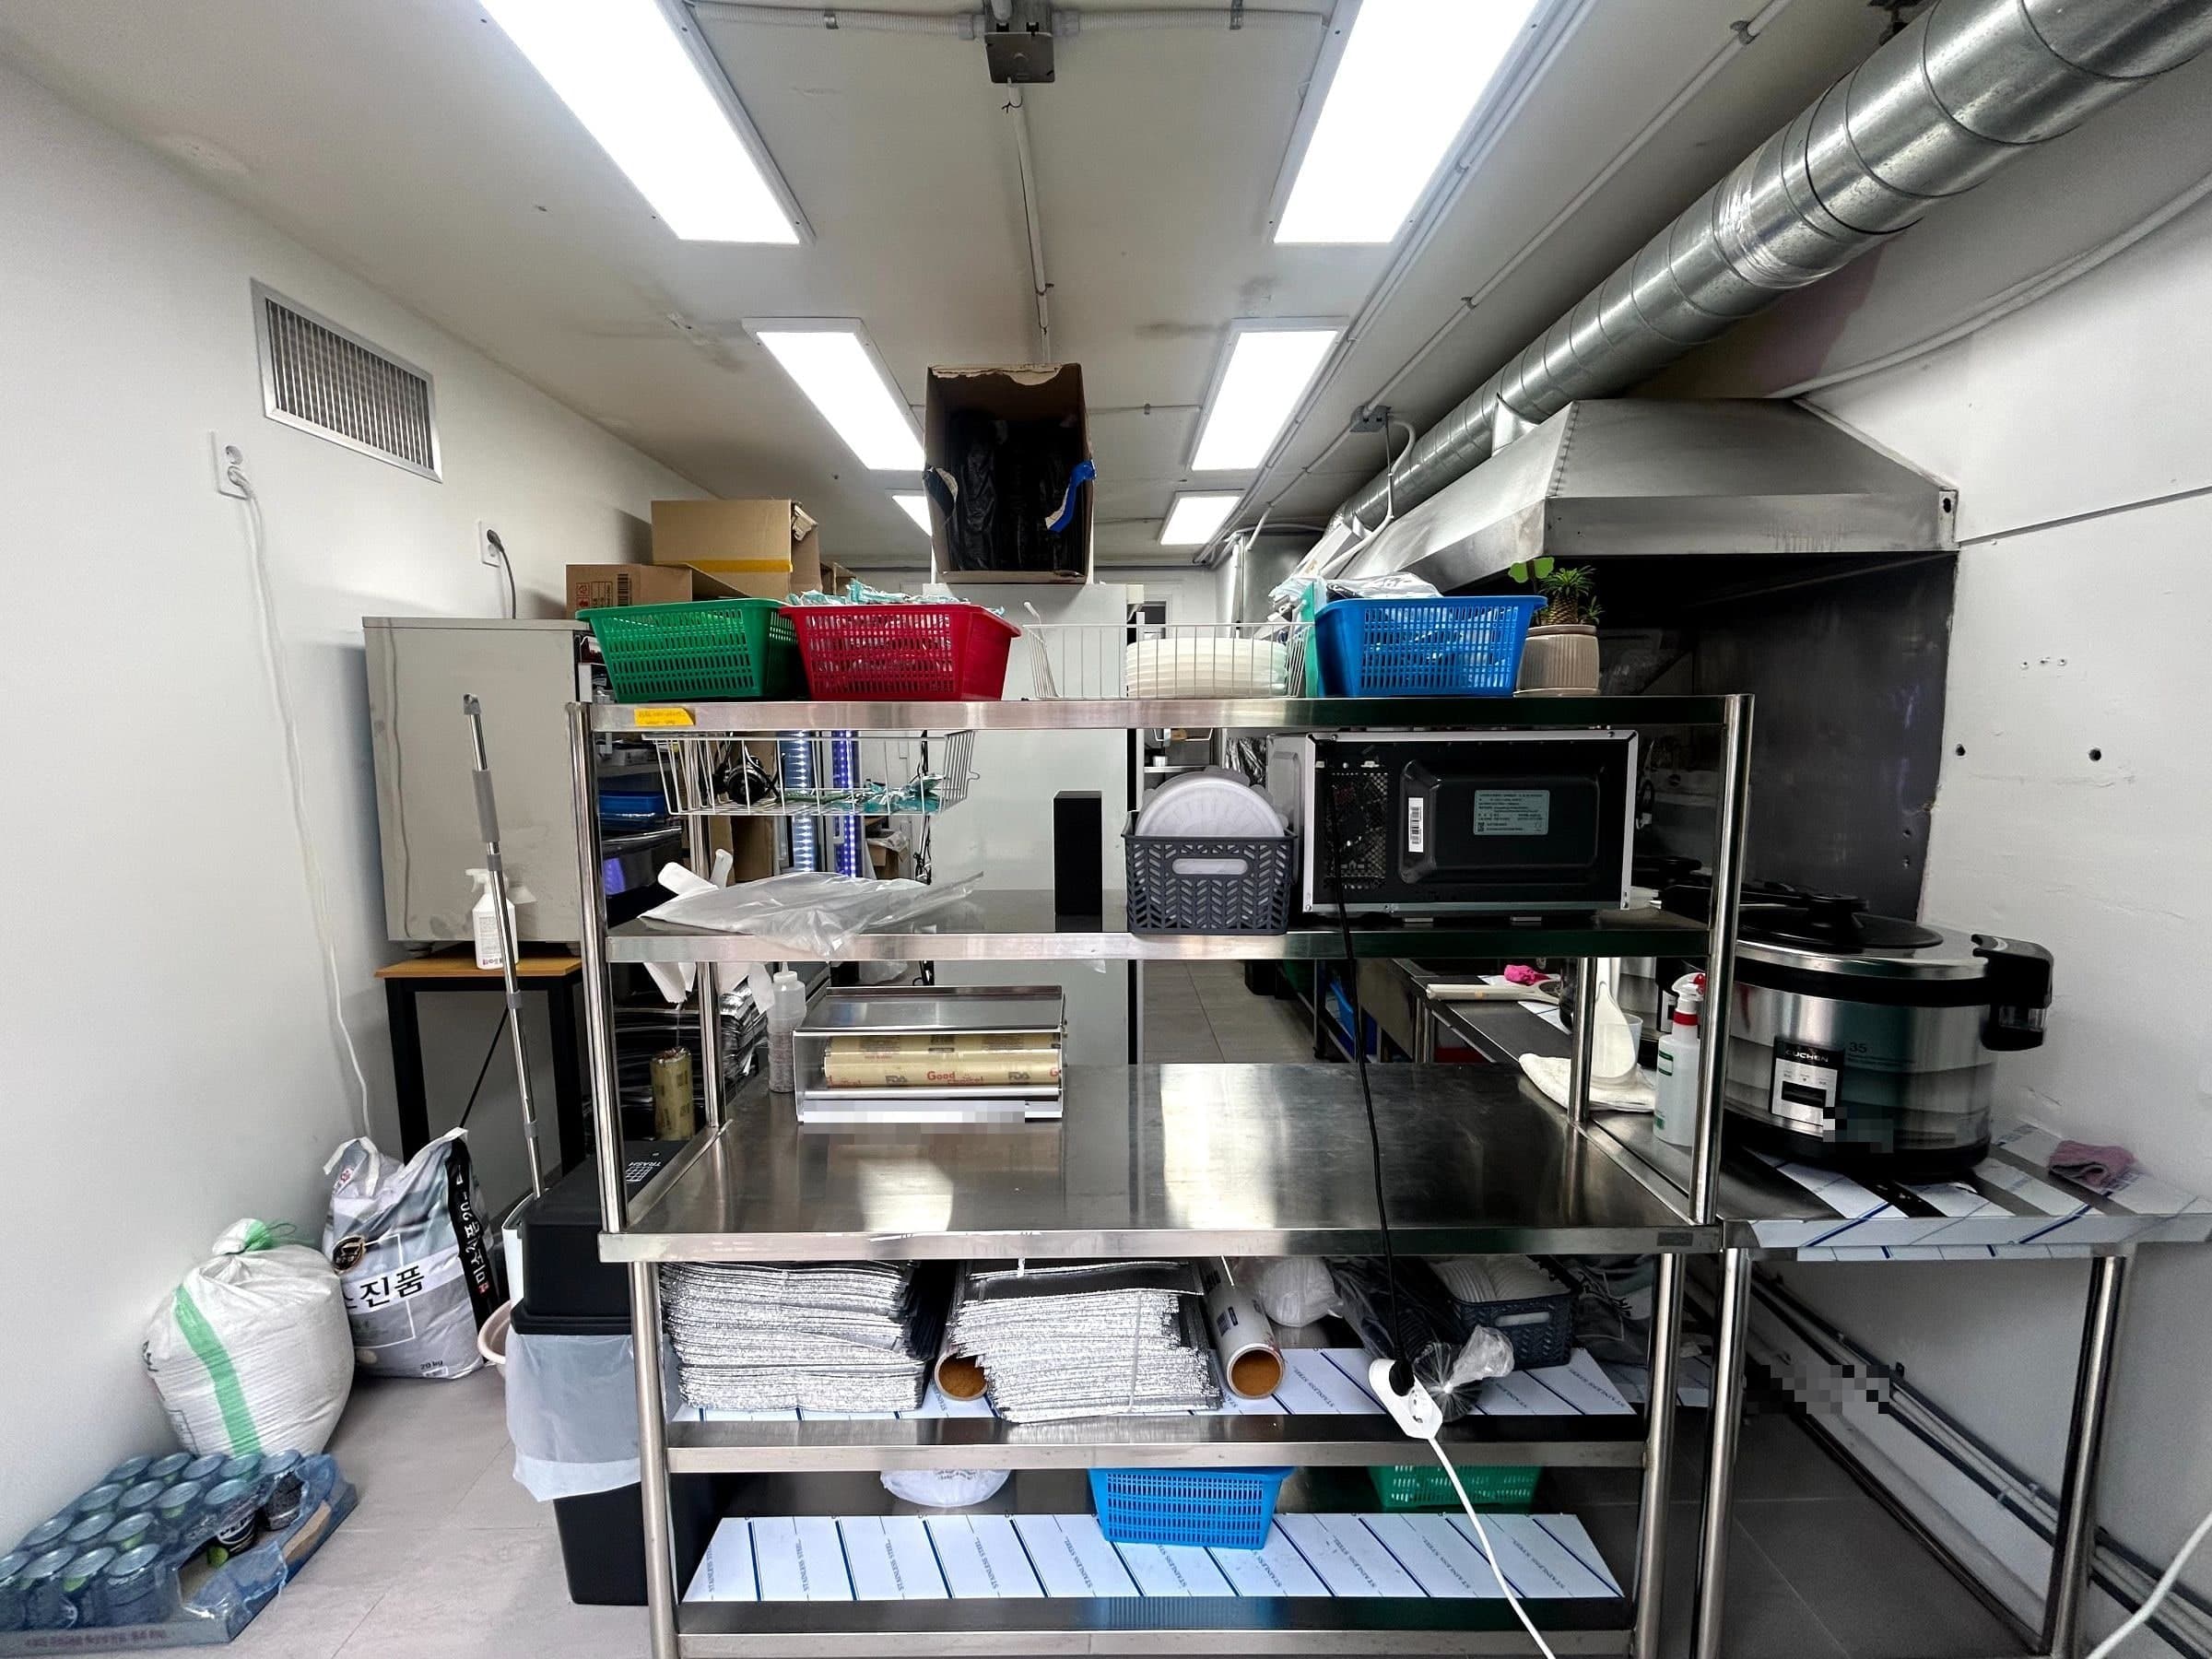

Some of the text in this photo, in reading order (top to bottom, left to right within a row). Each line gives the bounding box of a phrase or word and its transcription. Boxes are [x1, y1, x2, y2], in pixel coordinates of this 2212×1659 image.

[1784, 1049, 1829, 1063] CUCHEN
[1849, 1042, 1867, 1053] 35
[926, 1070, 956, 1081] Good
[1007, 1071, 1030, 1080] FDA
[798, 1559, 810, 1592] STAINLESS
[885, 1538, 904, 1592] STAINLESS STEEL
[974, 1536, 998, 1590] STAINLESS STEEL
[1064, 1535, 1093, 1589] STAINLESS STEEL
[1349, 1555, 1377, 1588] STAINLESS
[1440, 1556, 1472, 1590] STAINLESS
